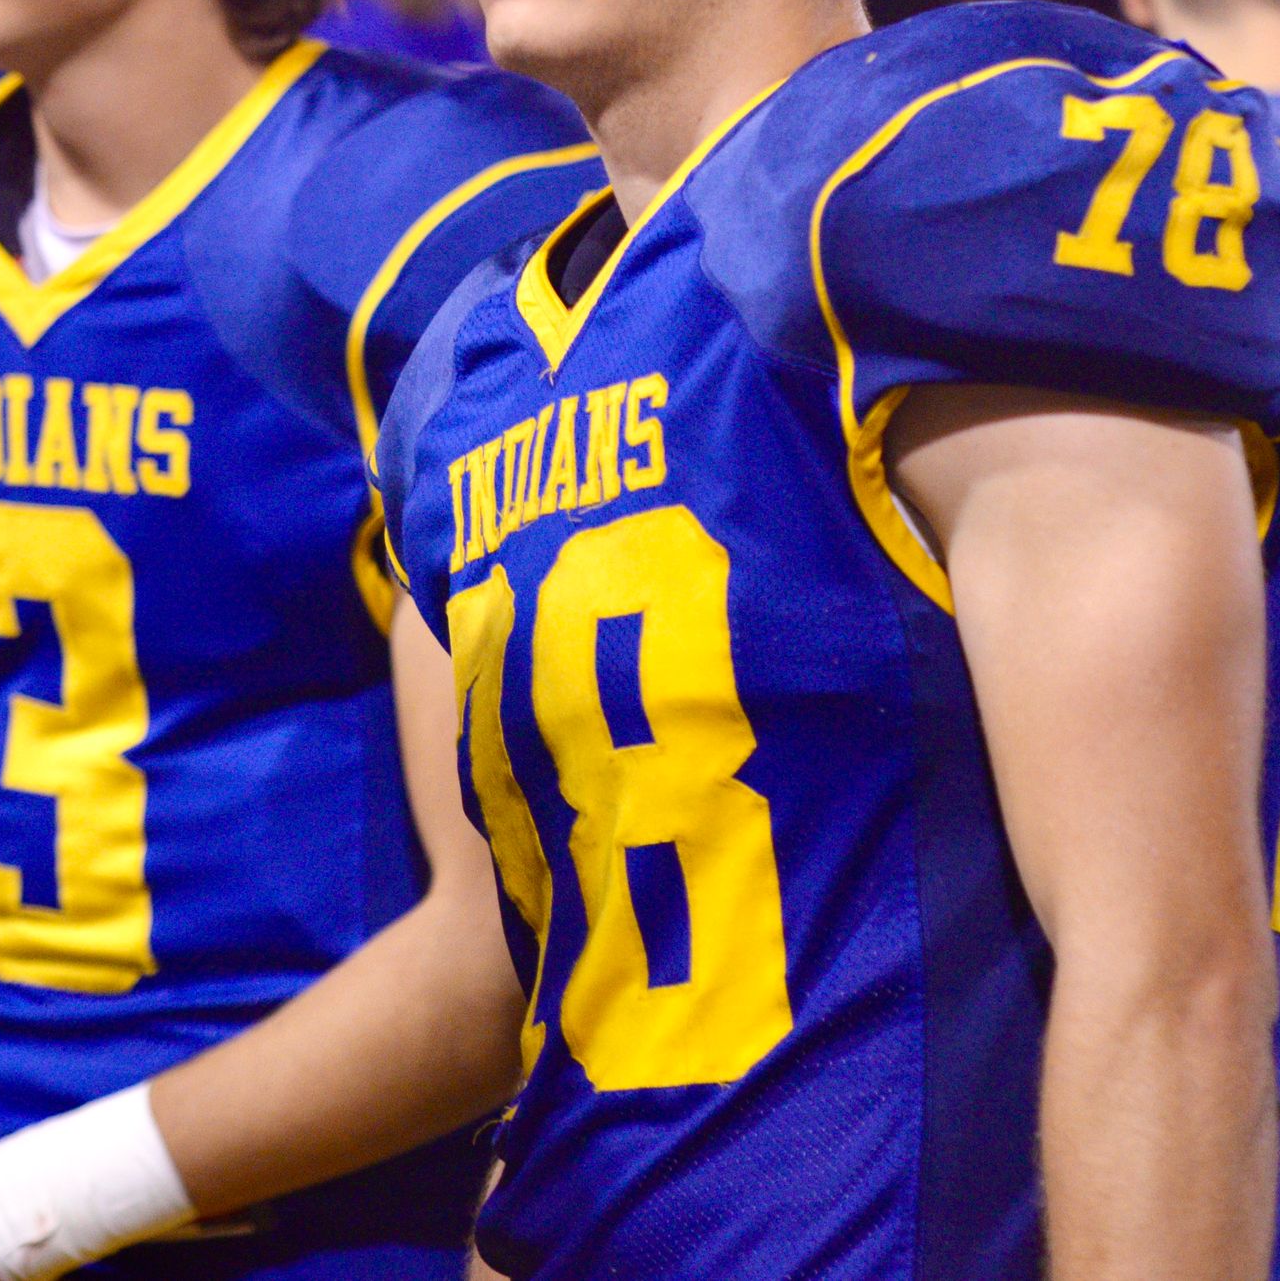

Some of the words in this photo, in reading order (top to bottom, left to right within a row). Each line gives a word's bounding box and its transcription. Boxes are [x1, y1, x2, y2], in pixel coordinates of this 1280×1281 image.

[1053, 94, 1261, 291] 78
[447, 371, 670, 575] INDIANS
[446, 504, 794, 1093] 78
